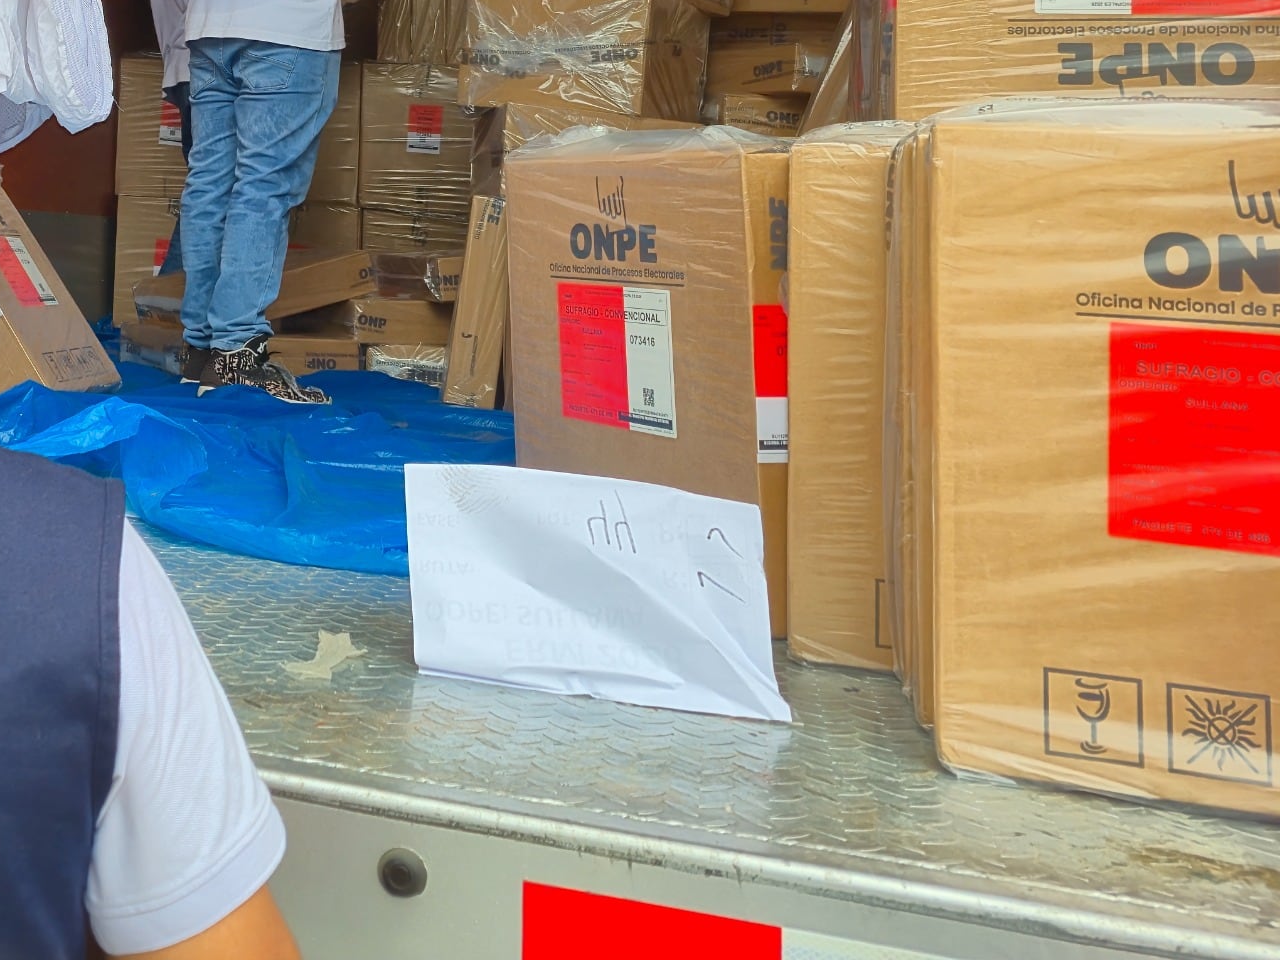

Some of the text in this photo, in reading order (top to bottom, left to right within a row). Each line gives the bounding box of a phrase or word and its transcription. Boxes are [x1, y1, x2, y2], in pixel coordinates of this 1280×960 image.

[1007, 25, 1085, 37] Electorales
[1089, 25, 1156, 37] Procesos
[1158, 25, 1178, 35] de
[1182, 24, 1251, 36] Nacional
[1057, 42, 1256, 86] ONPE
[766, 110, 800, 126] ONP
[570, 223, 658, 263] ONPE
[549, 263, 685, 280] Oficina Nacional de Procesos Electorales
[1144, 232, 1280, 295] ON
[1076, 292, 1143, 309] Oficina
[1148, 296, 1236, 315] Nacional
[1241, 302, 1267, 317] de
[565, 305, 599, 317] SUFRAGIO
[604, 309, 661, 323] CONVENCIONAL
[1136, 360, 1240, 383] SUFRAGIO
